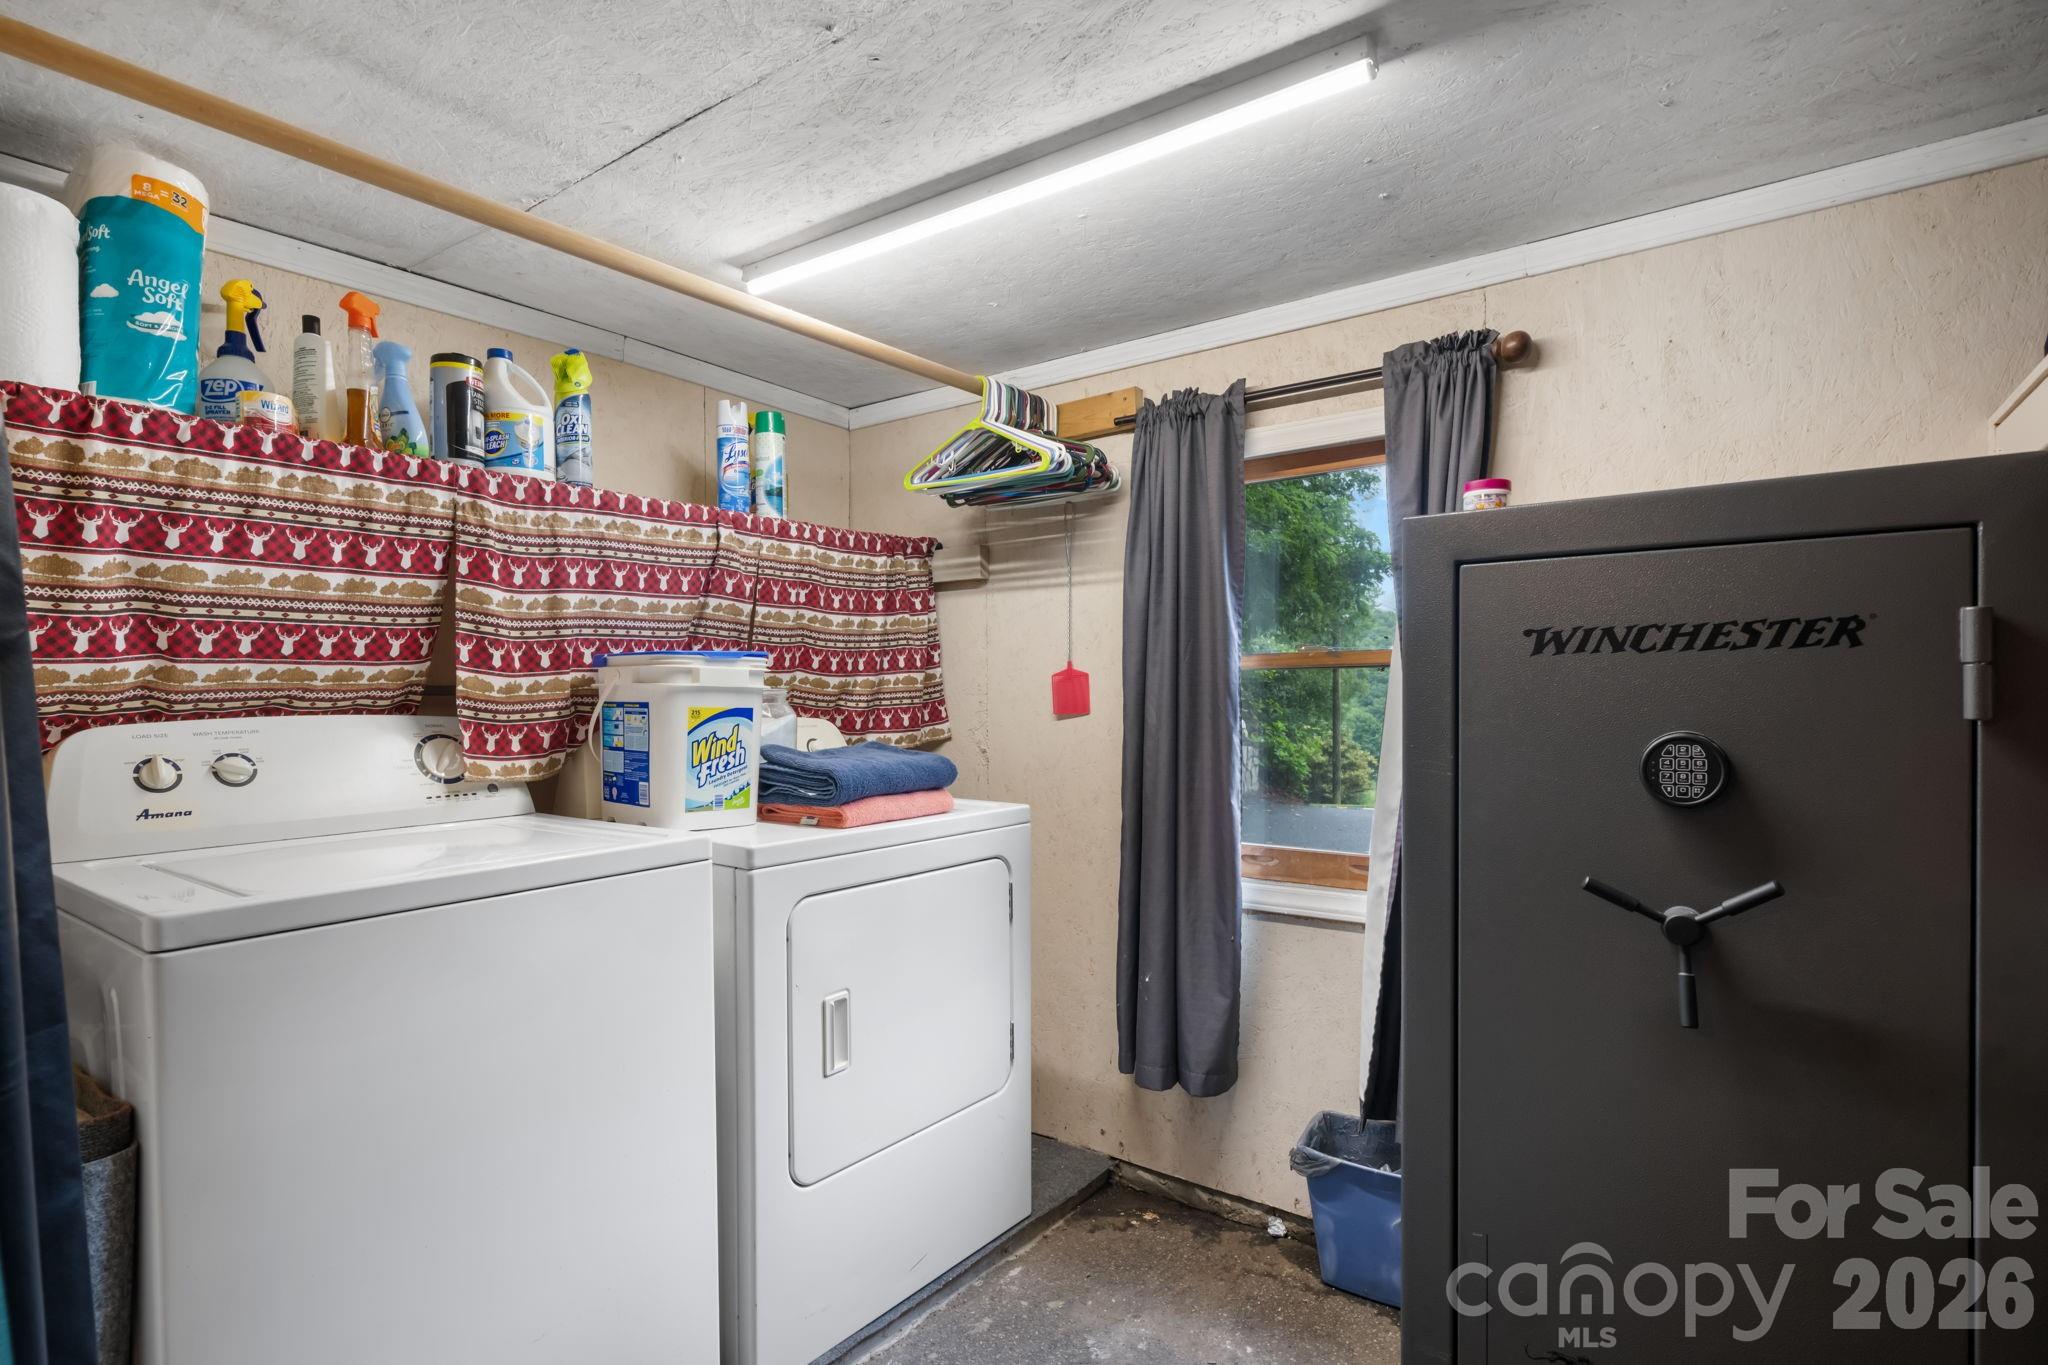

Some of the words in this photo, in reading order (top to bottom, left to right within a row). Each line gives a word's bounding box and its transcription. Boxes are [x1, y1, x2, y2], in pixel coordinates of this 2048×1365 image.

[172, 191, 188, 209] 32
[127, 268, 189, 300] Angel
[142, 286, 184, 312] Soft
[556, 423, 589, 436] CLEAN
[1522, 614, 1867, 658] WINCHESTER
[691, 723, 740, 769] Wind
[696, 740, 747, 789] Fresh
[135, 808, 193, 821] Amana
